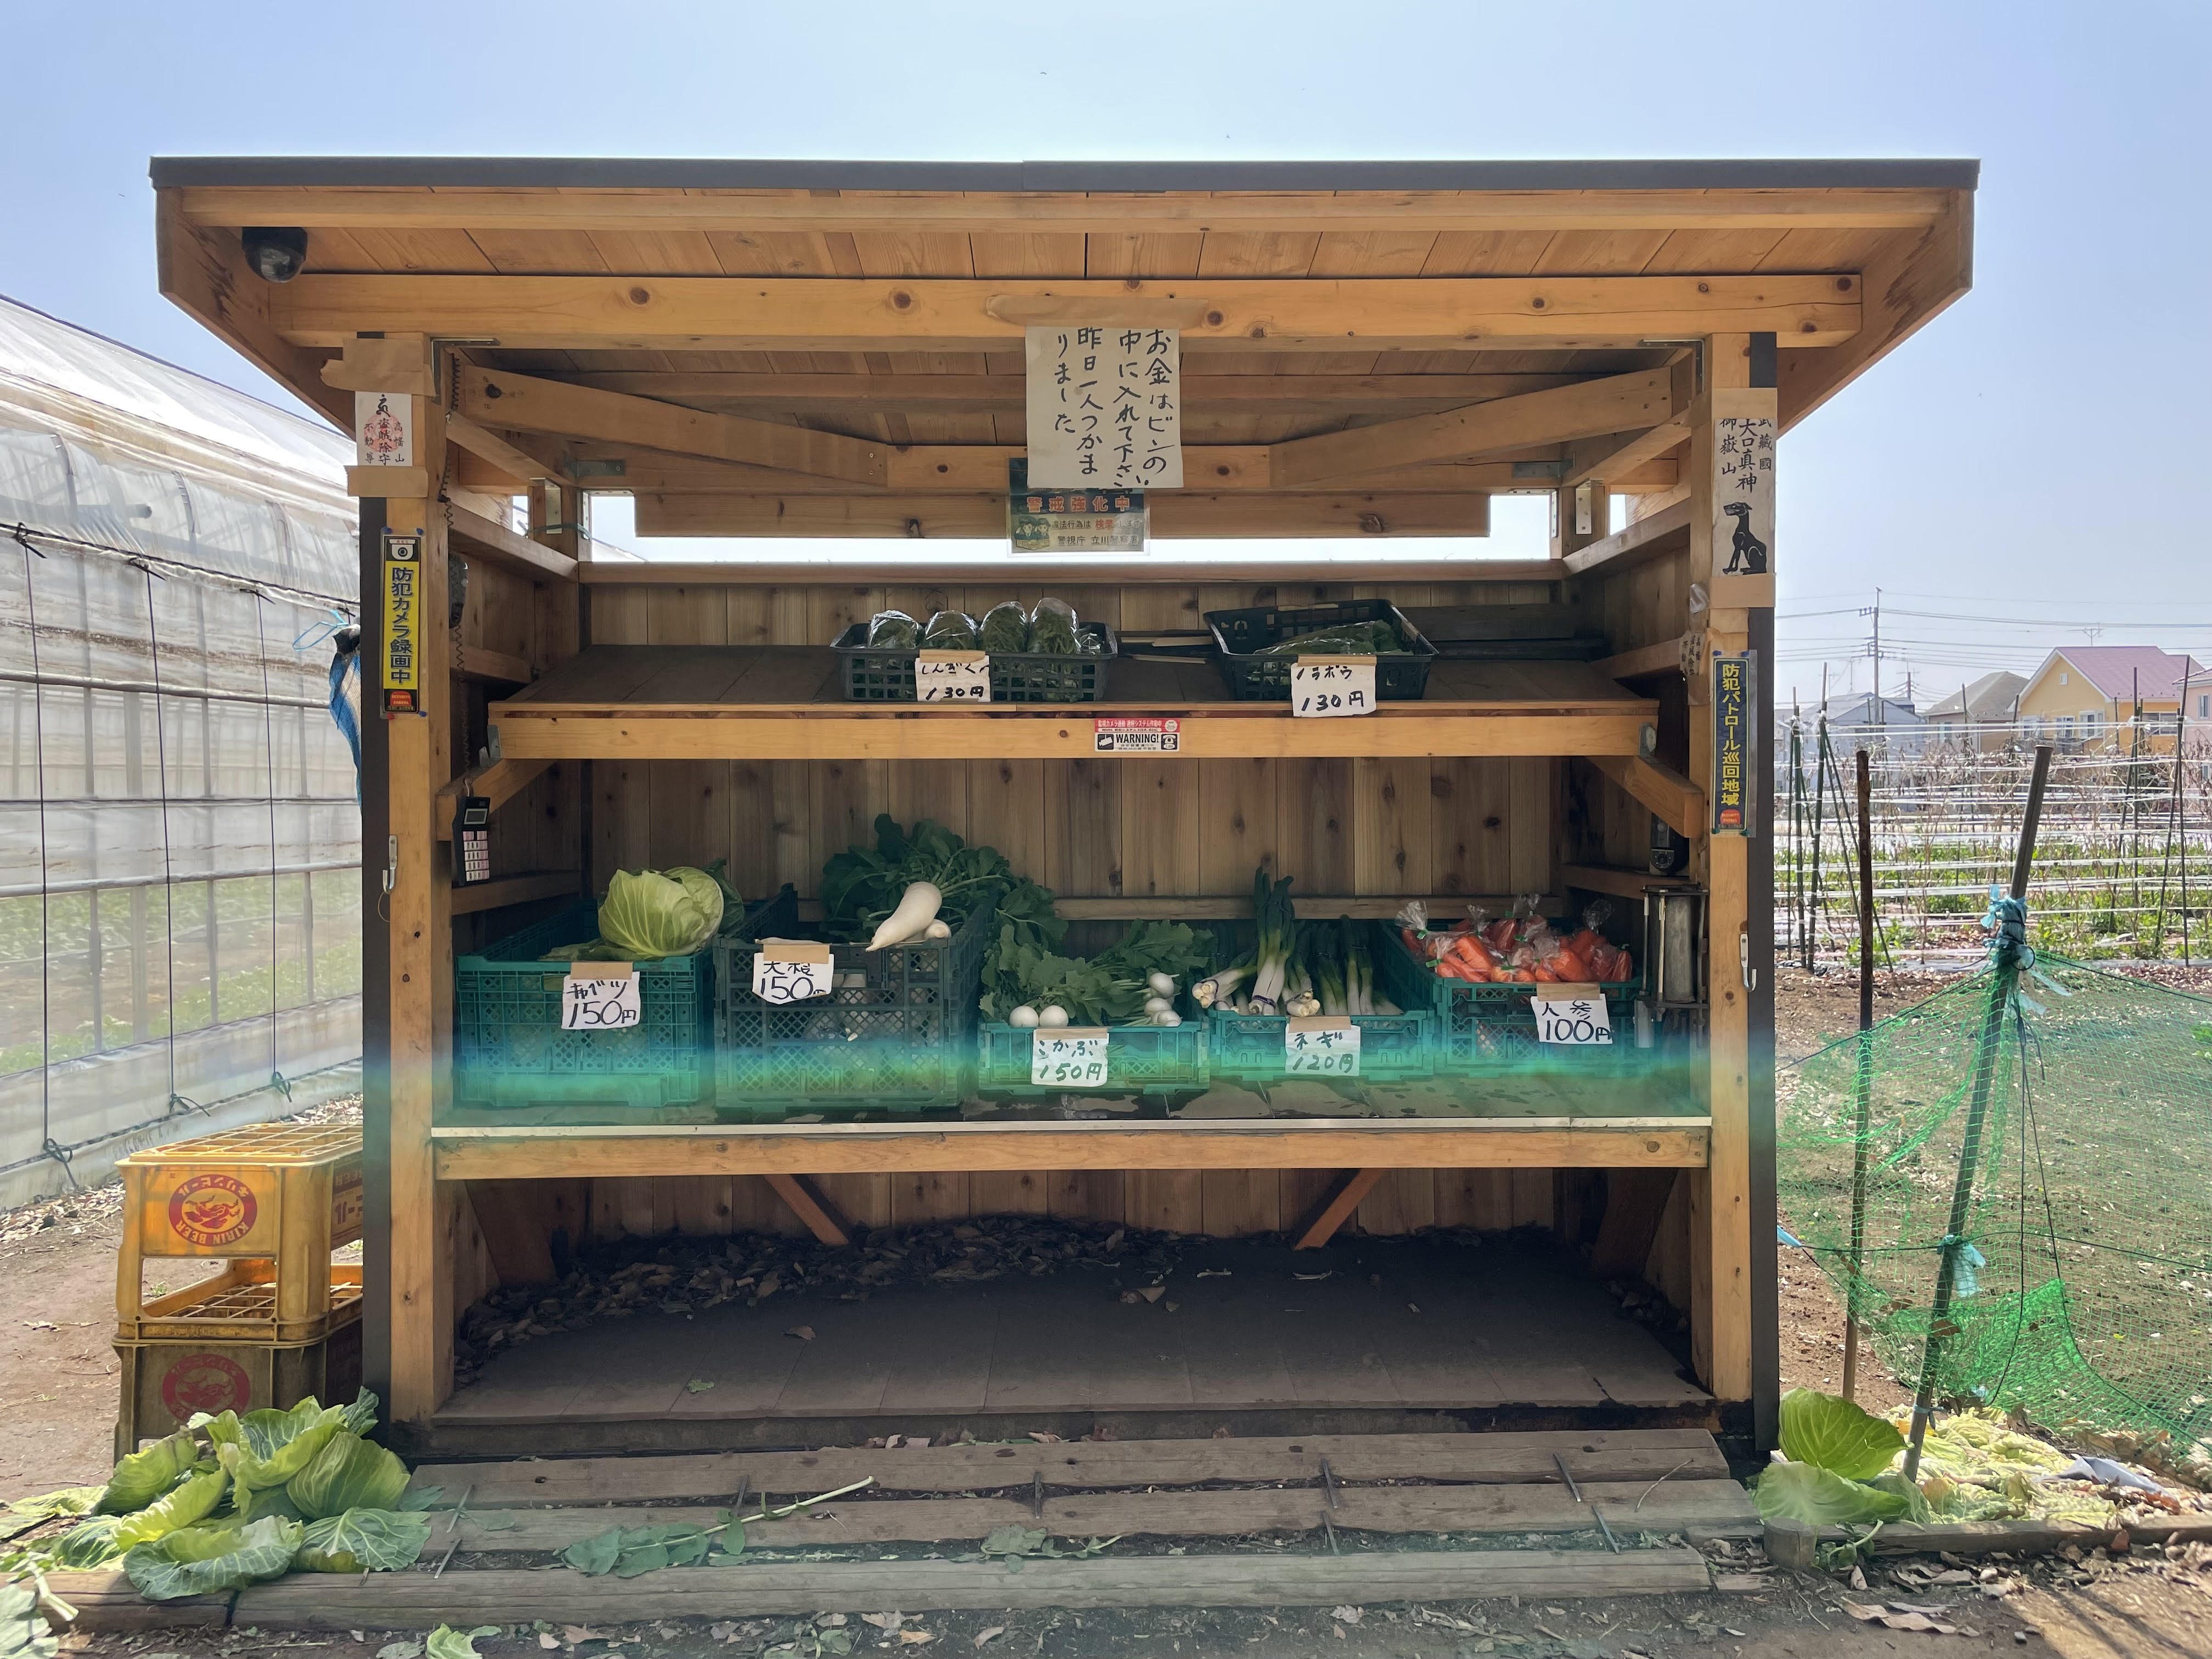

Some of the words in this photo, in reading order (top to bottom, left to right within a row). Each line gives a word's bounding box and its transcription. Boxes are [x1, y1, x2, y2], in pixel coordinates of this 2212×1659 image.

[1054, 334, 1075, 433] りました
[1077, 328, 1104, 475] 昨日一人つかま
[1113, 330, 1149, 487] 中に入れて下さい
[1143, 329, 1175, 474] お金はビンの
[1026, 496, 1131, 512] 警戒強化中
[390, 567, 414, 685] 防犯カメラ録画中
[1296, 665, 1352, 680] ノラボウ
[926, 686, 984, 701] 130円
[1301, 690, 1364, 712] 130円
[1116, 733, 1159, 743] WARNING!
[1721, 663, 1741, 806] 防犯パトロール巡回地域
[764, 961, 814, 977] 大根
[566, 980, 627, 999] キャベツ
[568, 1000, 636, 1028] 150円
[1294, 1031, 1343, 1050] ネギ
[1546, 1019, 1612, 1042] 100円
[1039, 1063, 1103, 1082] 150円
[1293, 1053, 1353, 1074] 120円
[178, 1176, 249, 1199] キリンビール
[175, 1220, 207, 1244] BEER
[212, 1221, 250, 1245] KIRIN
